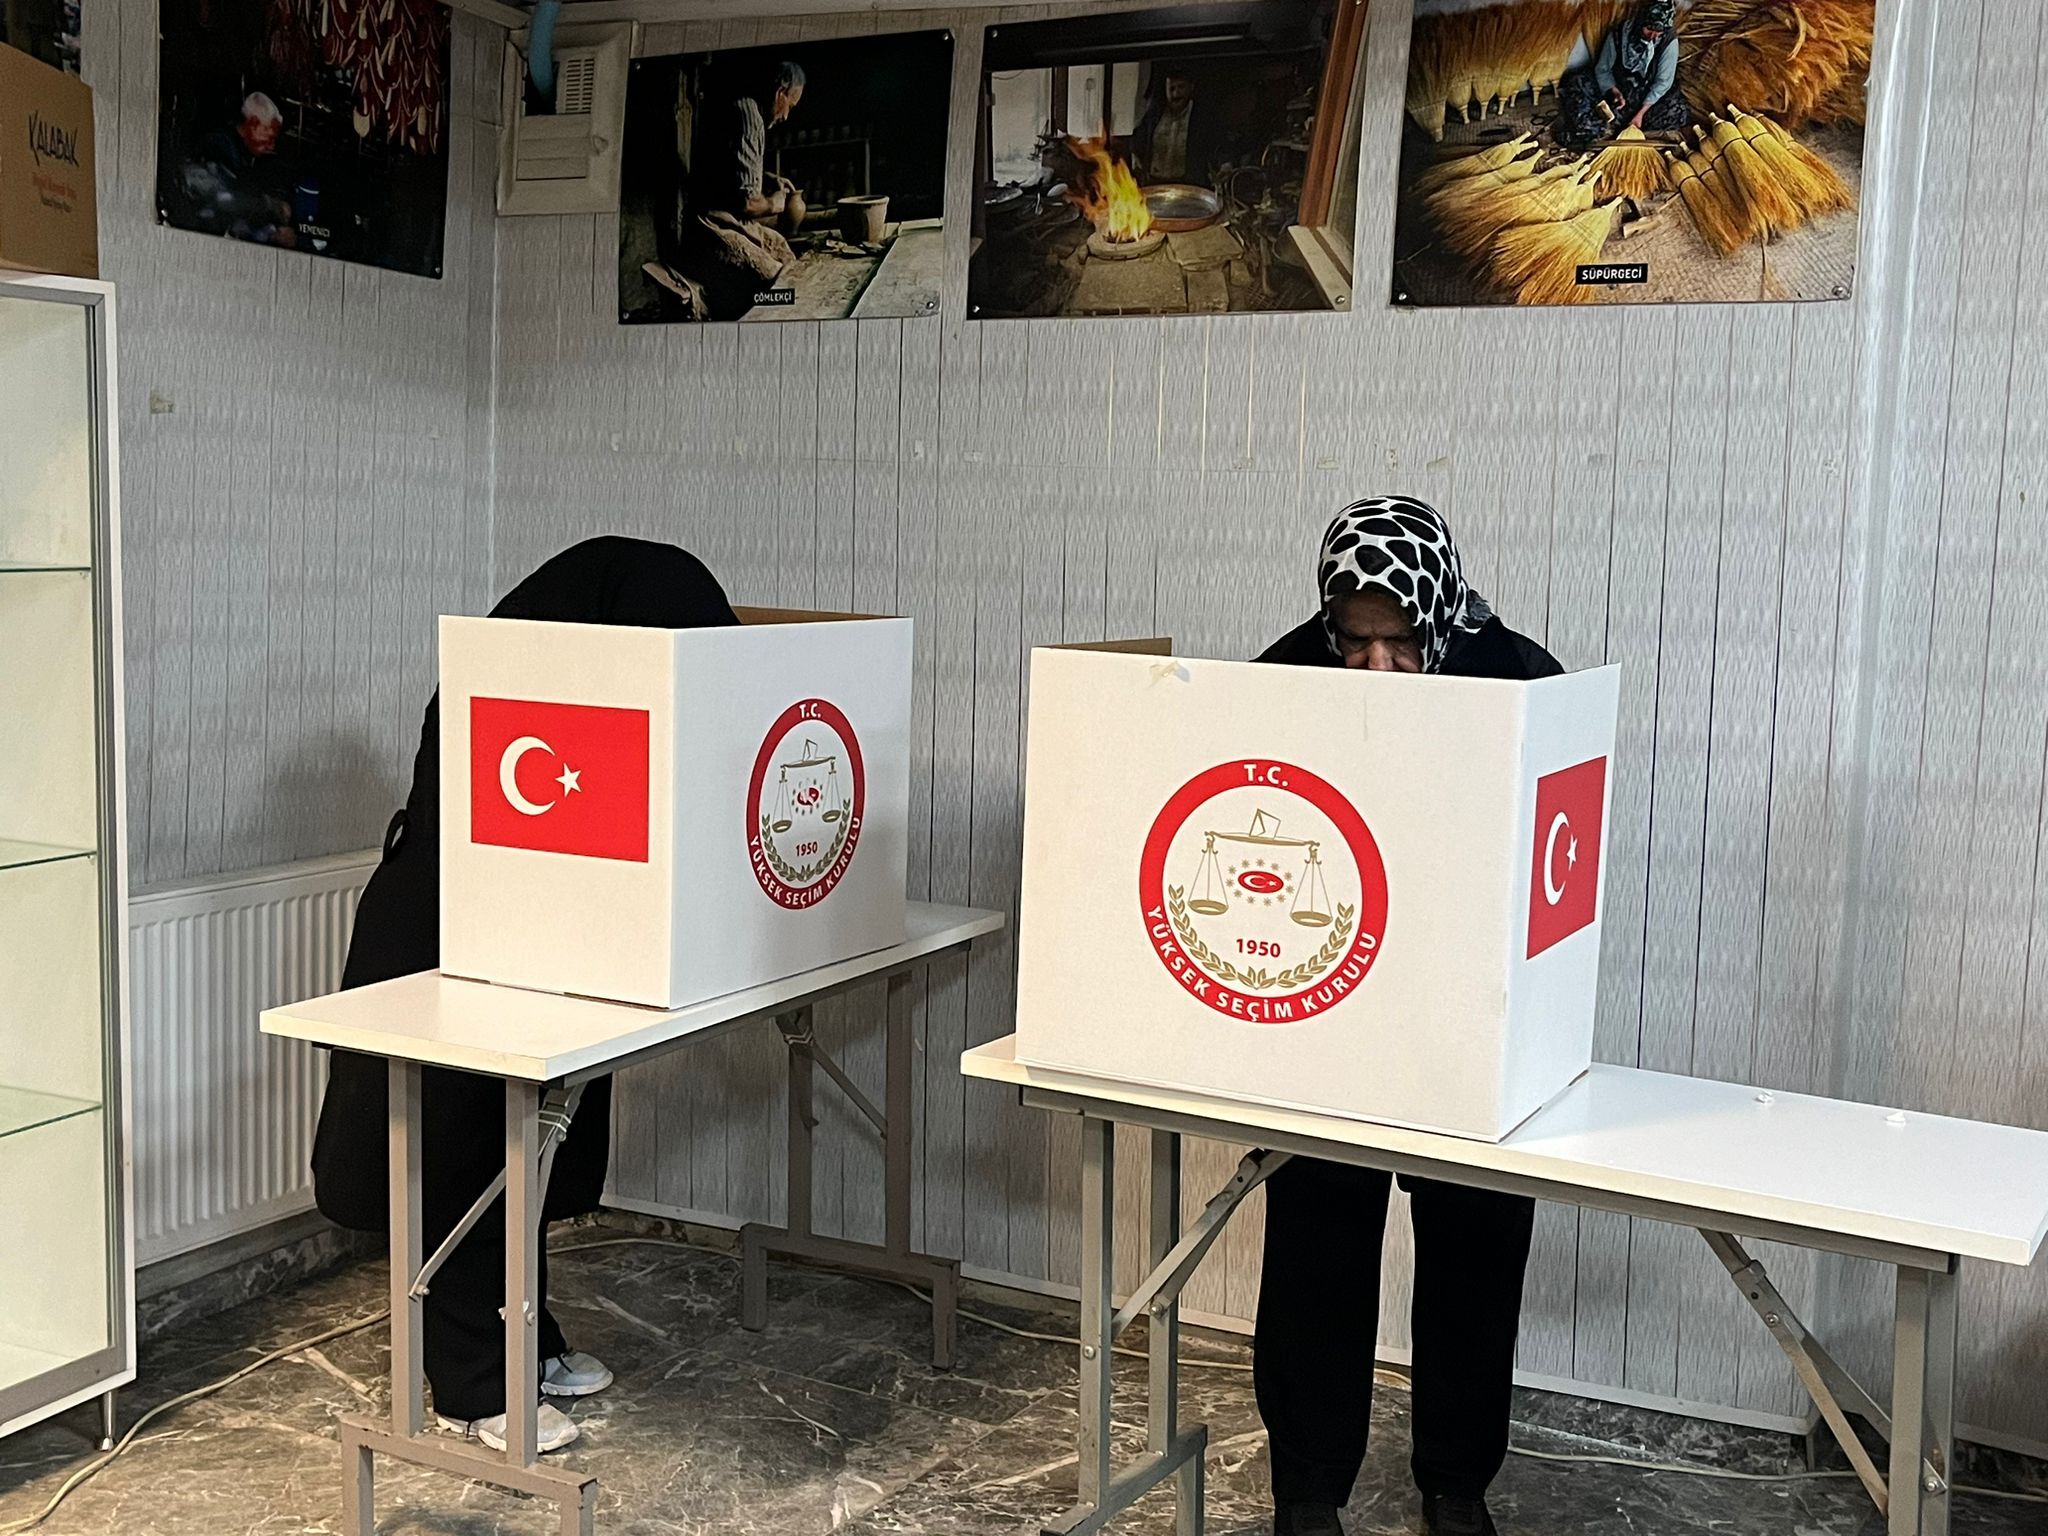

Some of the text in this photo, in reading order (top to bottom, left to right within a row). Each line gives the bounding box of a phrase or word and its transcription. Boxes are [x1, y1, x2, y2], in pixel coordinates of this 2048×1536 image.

[28, 110, 79, 167] KALABAK
[1581, 265, 1642, 280] SÜPÜRGECİ
[799, 702, 822, 719] T.C.
[1243, 763, 1289, 787] T.C.
[795, 841, 818, 857] 1950
[749, 816, 861, 908] YÜKSEK SEÇİM KURULU
[1235, 938, 1281, 958] 1950
[1146, 904, 1378, 1022] YÜKSEK SEÇİM KURULU
